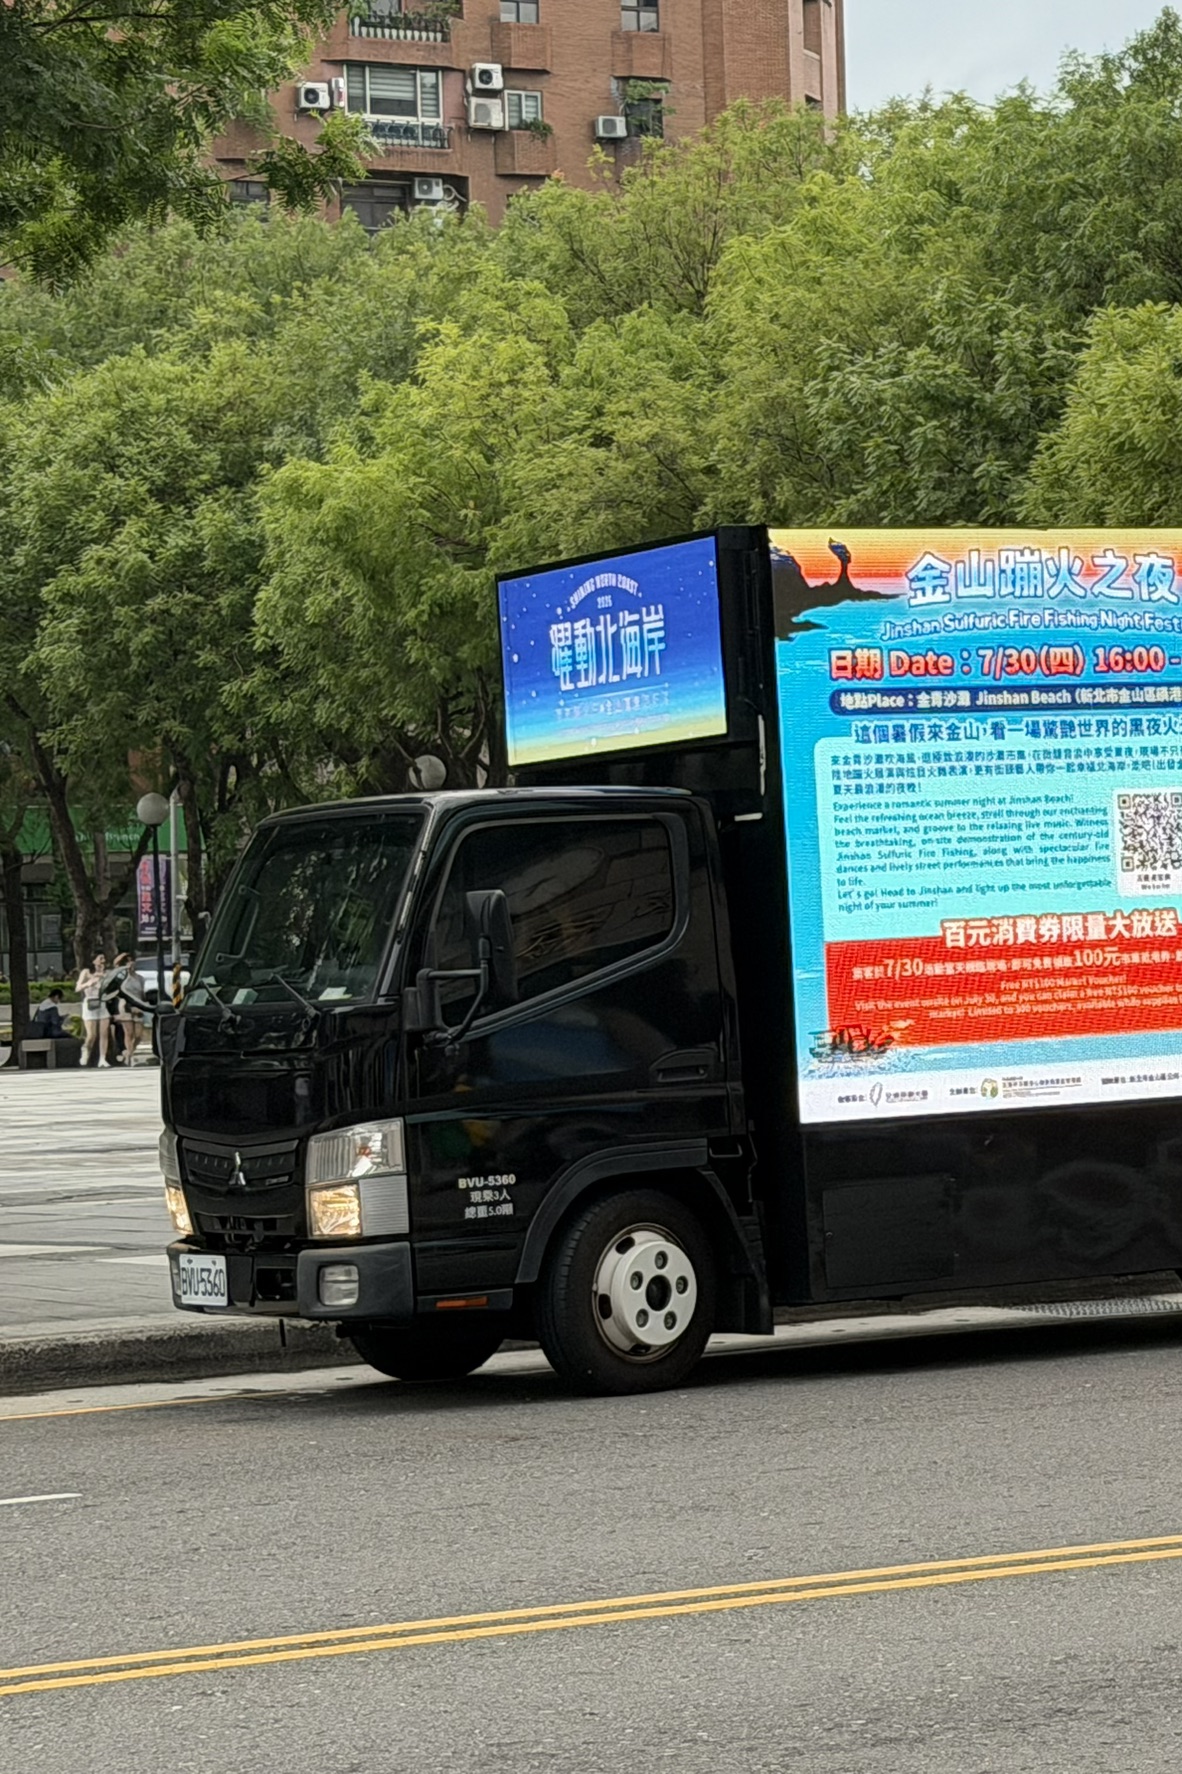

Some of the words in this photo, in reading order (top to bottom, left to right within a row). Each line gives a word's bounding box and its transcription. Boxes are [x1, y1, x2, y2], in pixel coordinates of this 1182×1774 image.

[906, 547, 1180, 607] 金山蹦火之夜
[881, 618, 941, 641] Jinshan
[943, 612, 1006, 631] Sulfuric
[1008, 608, 1041, 628] Fire
[1043, 608, 1098, 630] Fishing
[1100, 610, 1143, 631] Night
[829, 646, 884, 682] 日期
[1093, 643, 1166, 673] 16:00
[975, 690, 1029, 706] Jinshan
[1031, 689, 1072, 705] Beach
[943, 910, 1177, 948] 百元消費券限量大放送
[458, 1173, 516, 1189] BVU-5360
